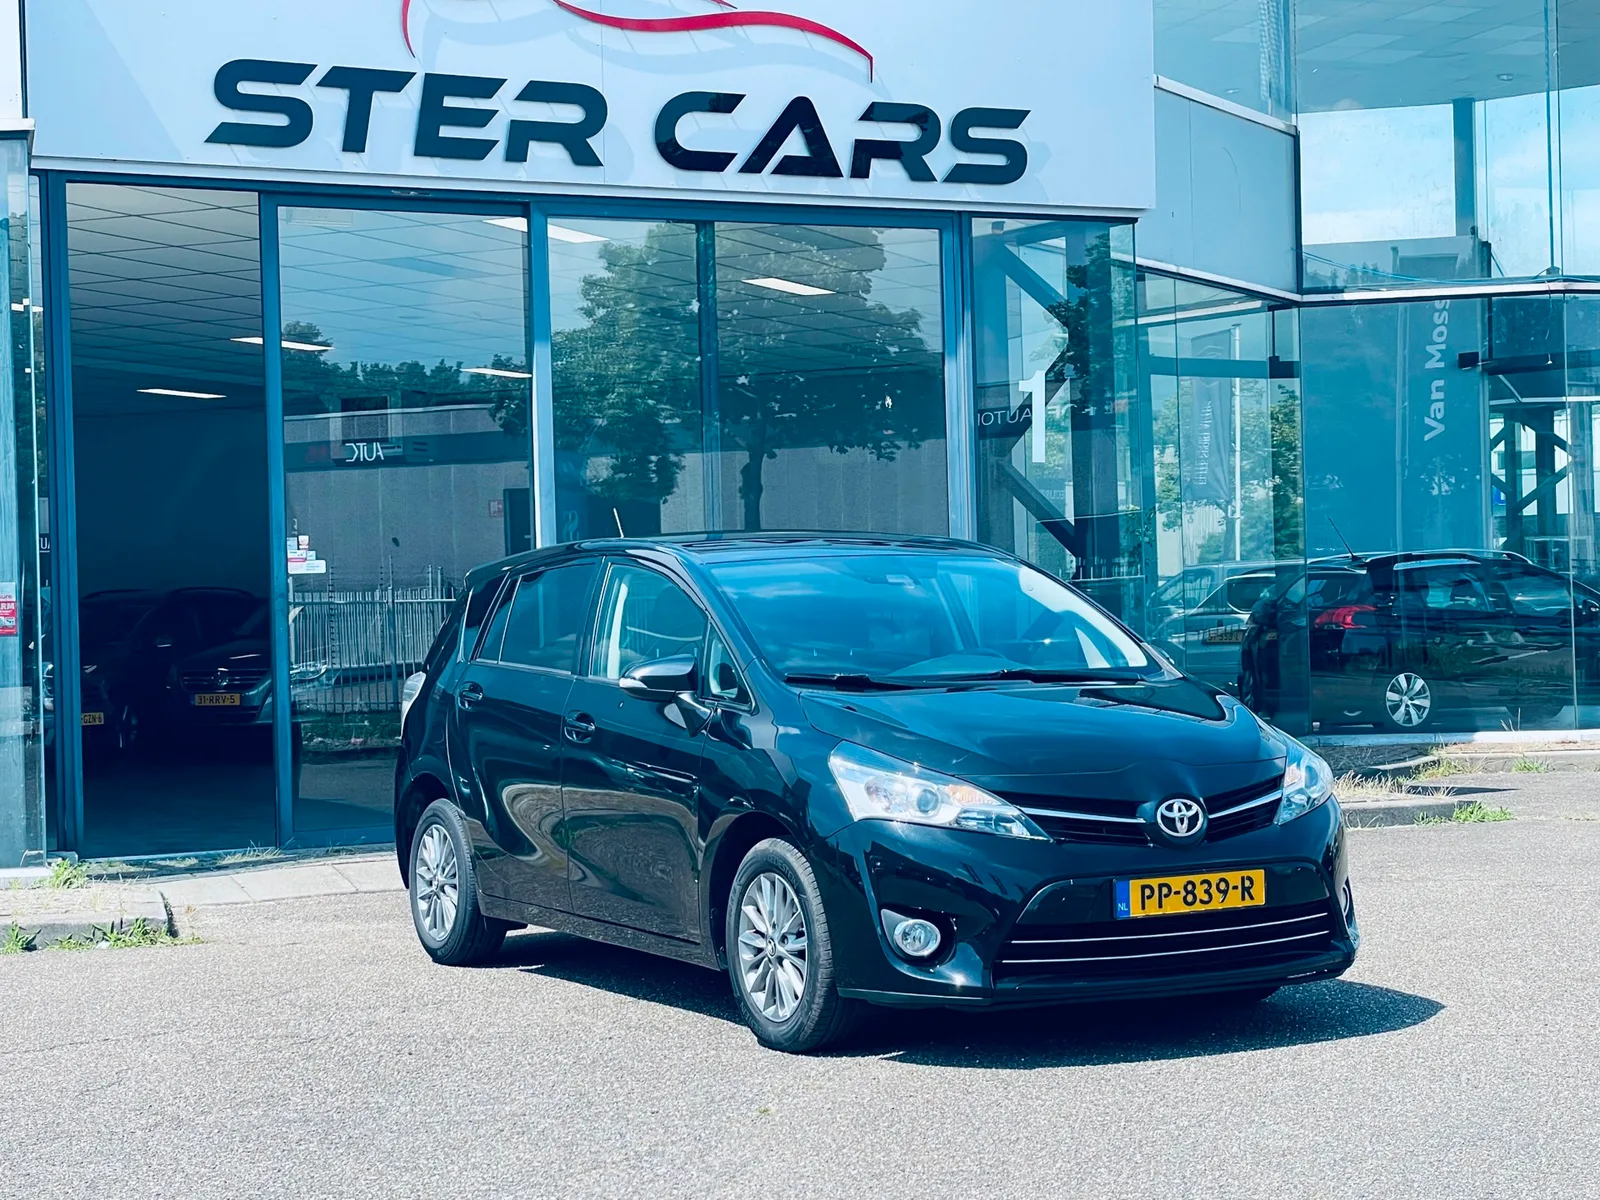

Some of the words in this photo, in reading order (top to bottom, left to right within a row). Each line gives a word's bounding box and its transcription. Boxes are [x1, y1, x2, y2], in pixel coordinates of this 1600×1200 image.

[204, 58, 608, 167] STER
[654, 90, 1032, 185] CARS
[1018, 369, 1046, 463] 1
[1424, 380, 1446, 442] Van
[197, 694, 236, 705] 31-RRV-5
[1118, 903, 1128, 911] NL
[1140, 875, 1255, 911] PP-839-R
